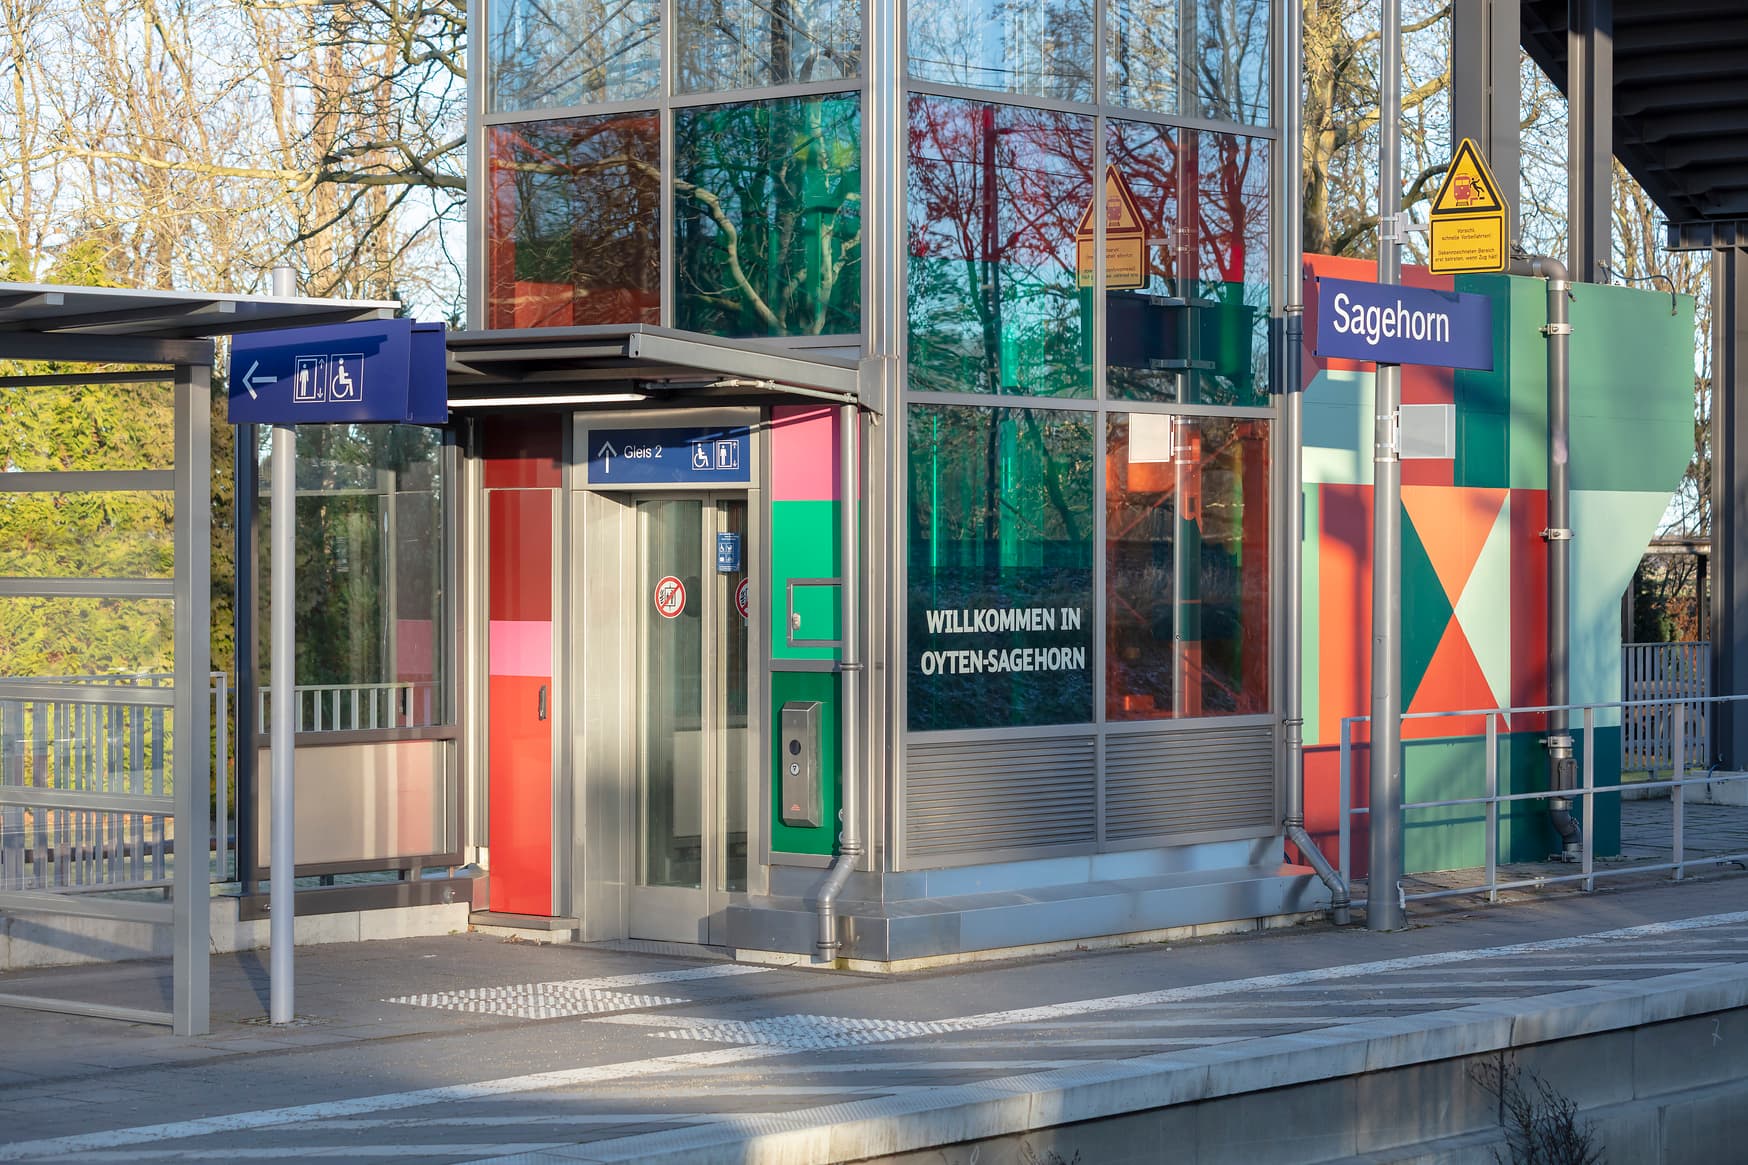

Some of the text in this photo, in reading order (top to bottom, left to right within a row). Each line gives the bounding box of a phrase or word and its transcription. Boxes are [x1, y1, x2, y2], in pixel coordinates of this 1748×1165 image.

[1333, 292, 1450, 346] Sagehorn
[624, 445, 663, 459] Gleis 2
[926, 607, 1081, 634] WILLKOMMEN IN
[921, 646, 1086, 676] OYTEN-SAGEHORN
